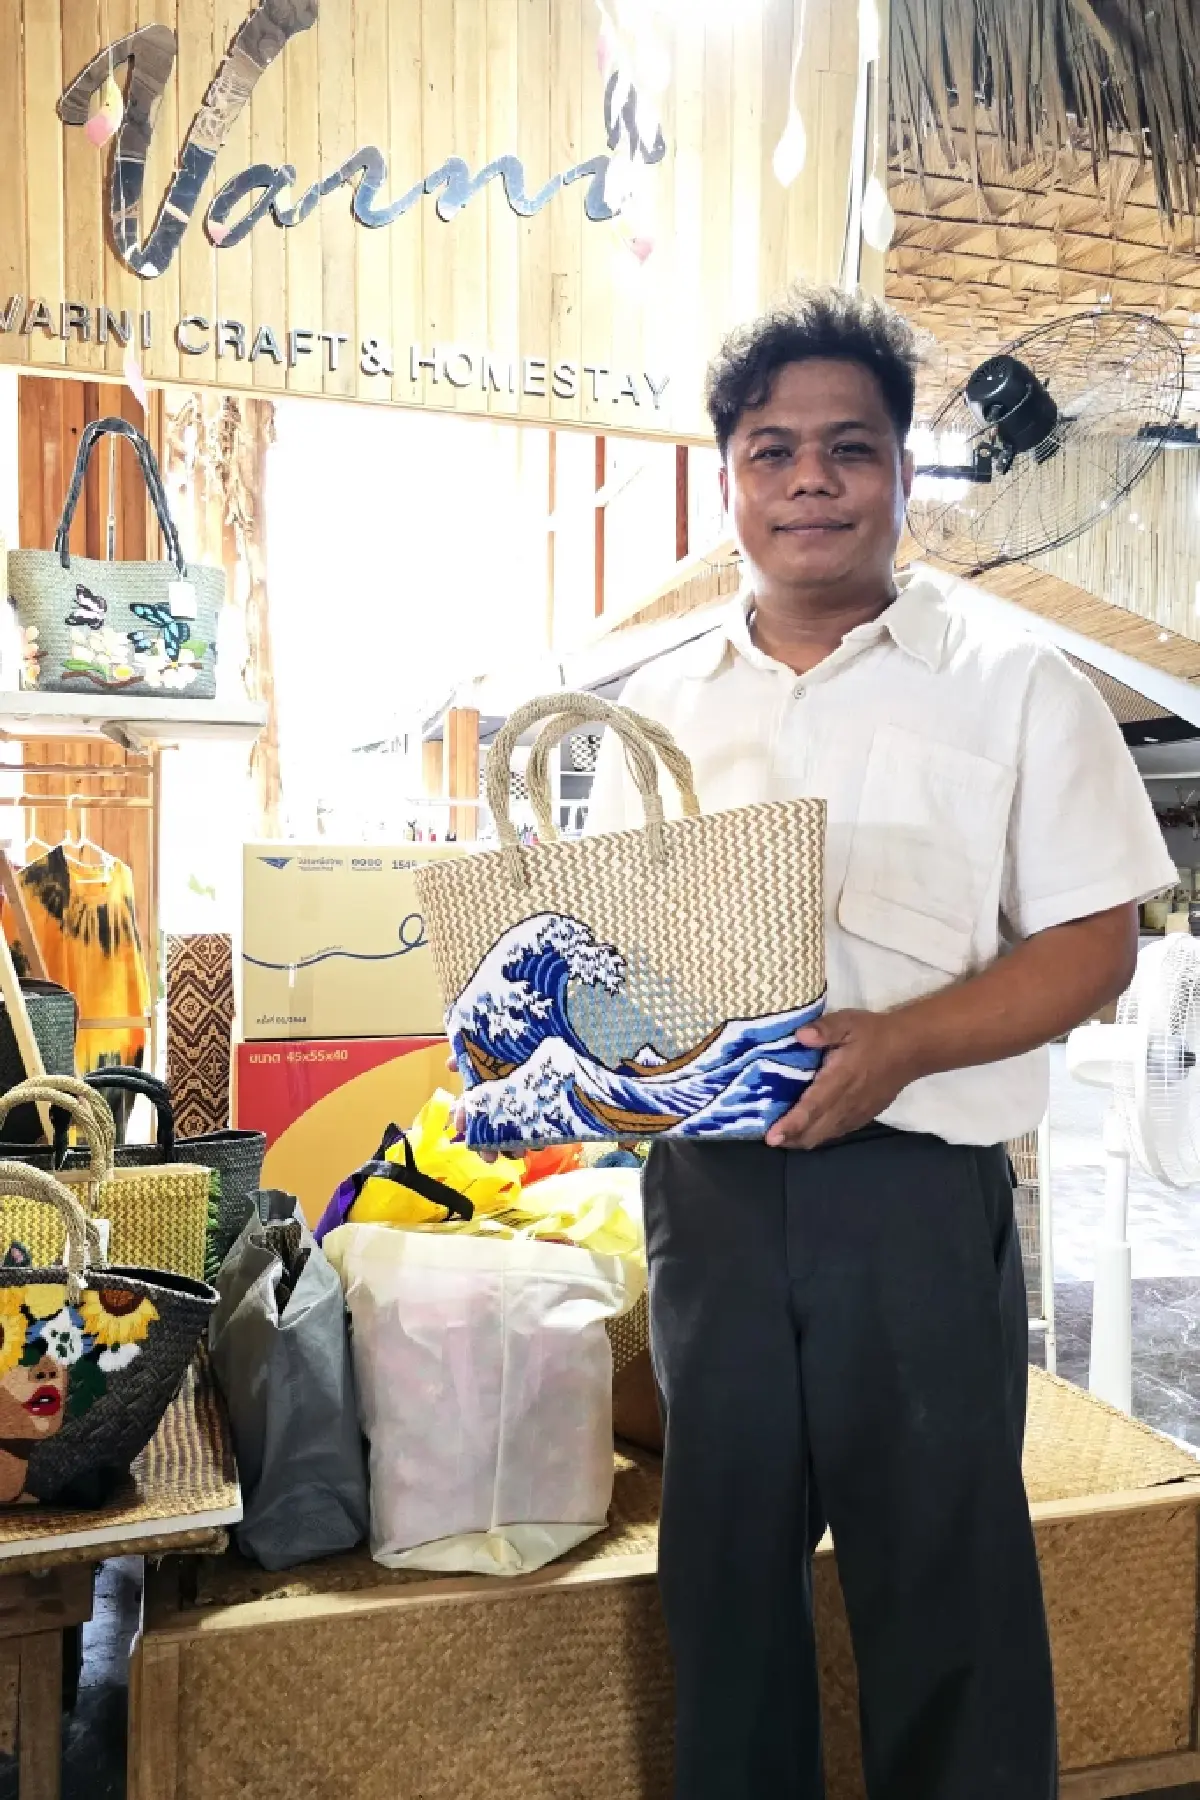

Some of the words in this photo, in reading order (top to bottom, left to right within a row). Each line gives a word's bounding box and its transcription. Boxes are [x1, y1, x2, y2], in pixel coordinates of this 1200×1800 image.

[0, 293, 151, 350] VARNI
[174, 315, 348, 372] CRAFT
[359, 334, 395, 377] &
[408, 343, 671, 410] HOMESTAY
[286, 1049, 348, 1063] 45x55x40
